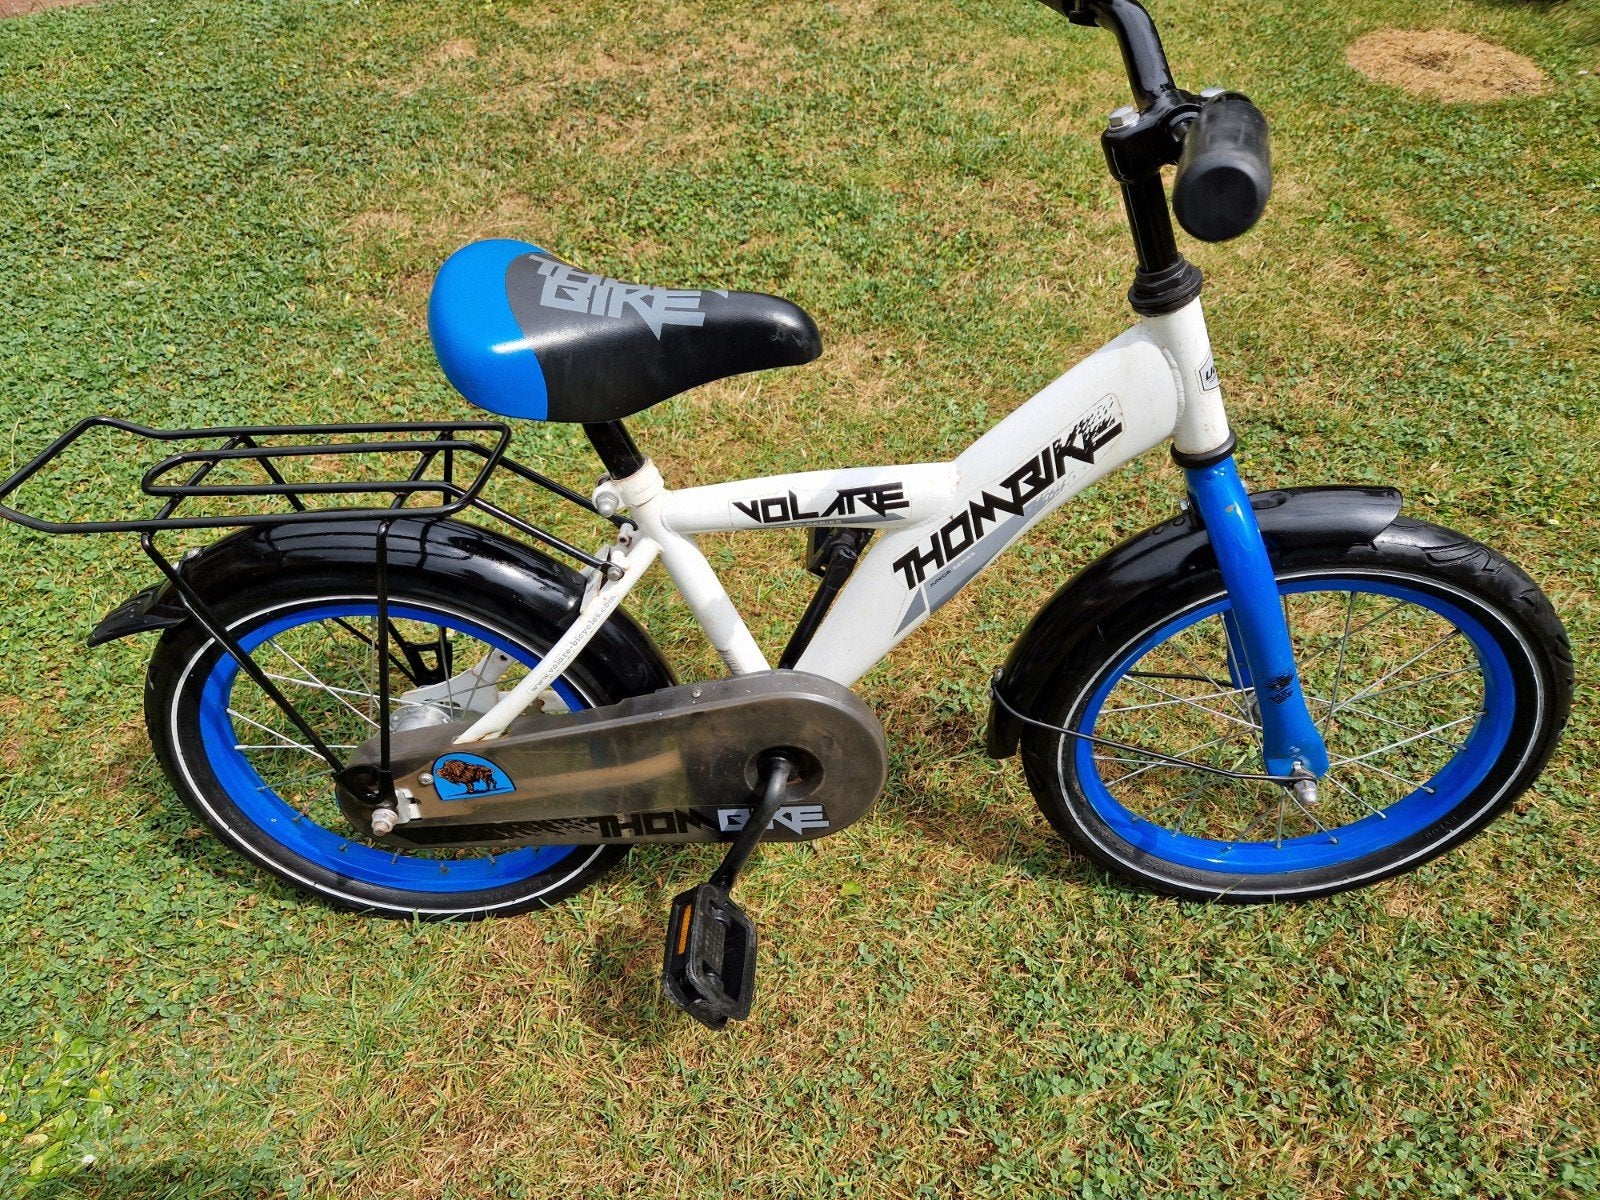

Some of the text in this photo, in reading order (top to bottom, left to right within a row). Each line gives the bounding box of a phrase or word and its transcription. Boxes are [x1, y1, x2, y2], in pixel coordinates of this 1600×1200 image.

[540, 276, 706, 341] BIKE
[732, 481, 910, 523] VOLARE
[531, 594, 617, 692] www.volare-bicycles.com
